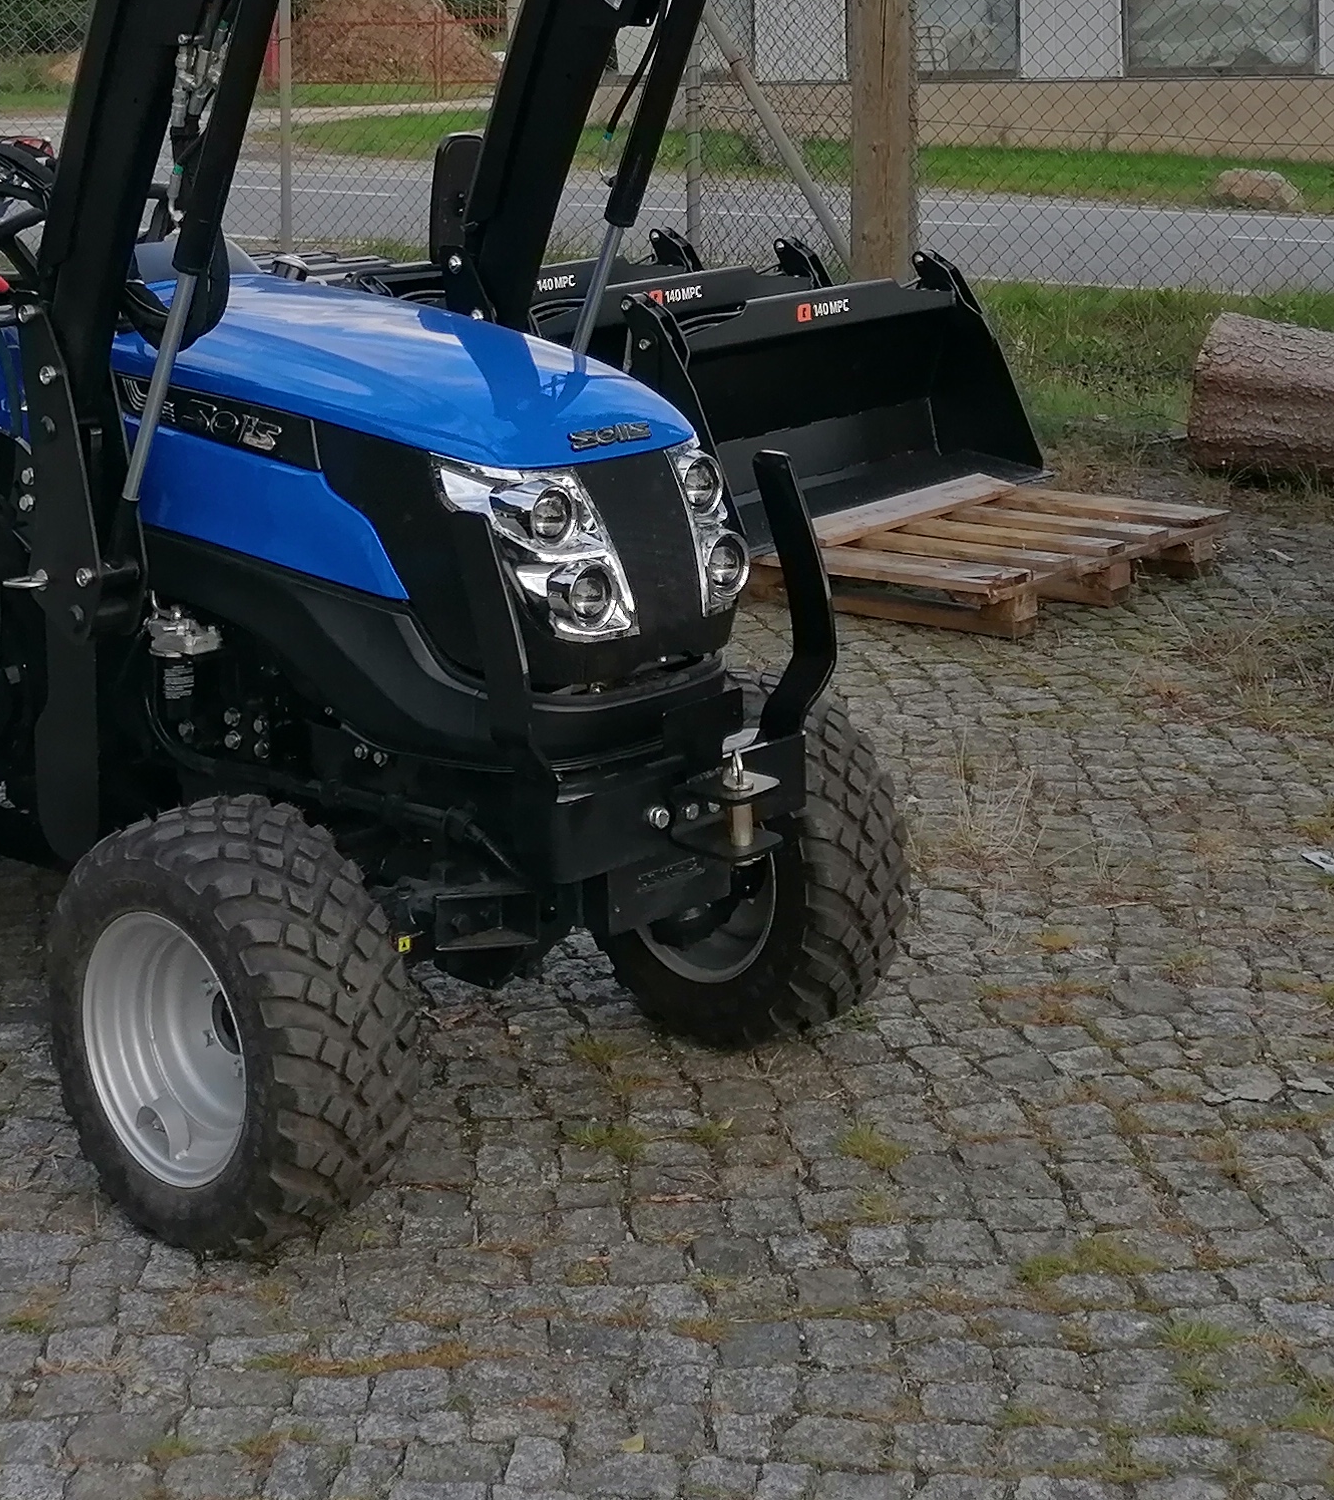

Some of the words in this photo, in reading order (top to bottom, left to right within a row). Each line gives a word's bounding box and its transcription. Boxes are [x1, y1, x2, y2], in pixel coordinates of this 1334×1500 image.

[536, 278, 554, 293] 140
[553, 274, 577, 290] MPC
[664, 288, 681, 303] 140
[681, 285, 703, 300] MPC
[812, 302, 829, 317] 140
[829, 298, 850, 315] MPC
